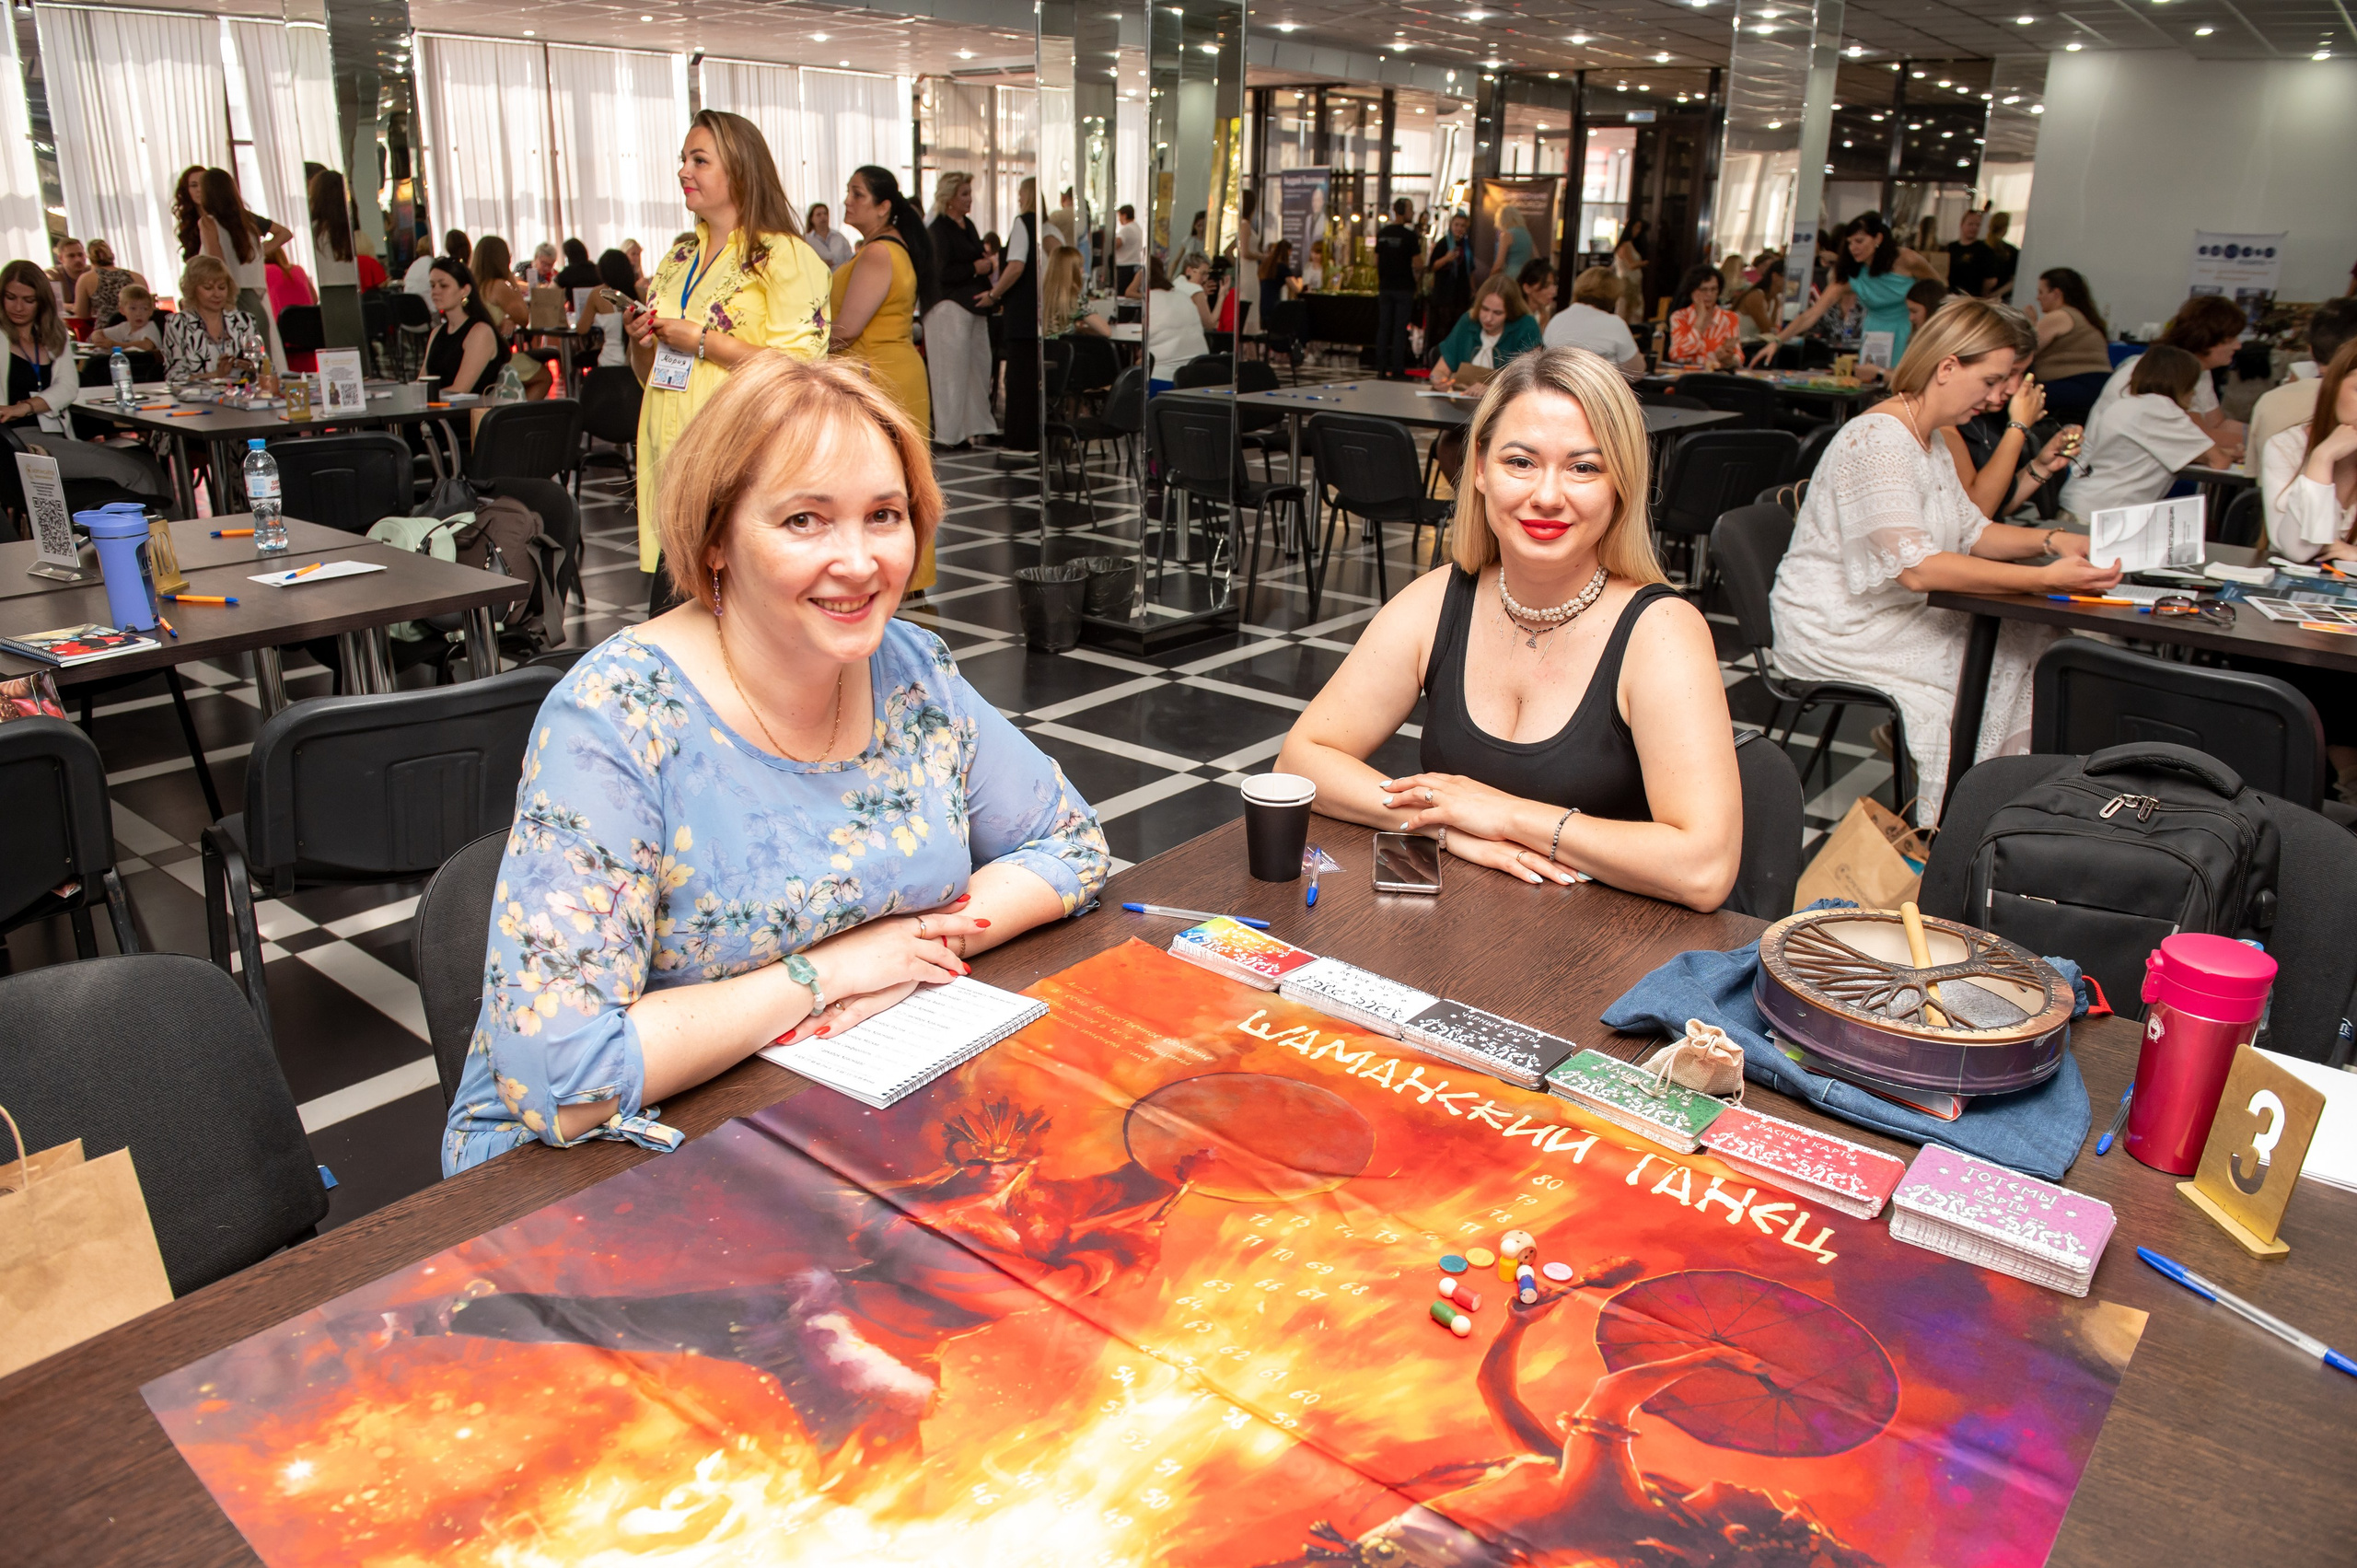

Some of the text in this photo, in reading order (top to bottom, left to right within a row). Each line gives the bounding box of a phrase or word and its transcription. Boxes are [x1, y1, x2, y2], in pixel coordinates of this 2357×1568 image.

[1462, 1011, 1540, 1044] ЧЕРНЫЕ КАРТЫ
[1237, 1008, 1839, 1265] ШАМАНСКИЙ ТАНЕЦ
[1749, 1120, 1858, 1161] КРАСНЫЕ КАРТЫ
[2226, 1088, 2286, 1196] 3
[1531, 1174, 1564, 1191] 80
[1966, 1166, 2058, 1205] ТОТЕМЫ
[1515, 1193, 1538, 1205] 79
[1972, 1188, 2030, 1214] КАРТЫ
[1248, 1213, 1273, 1227] 72
[1289, 1214, 1311, 1228] 73
[1489, 1208, 1513, 1224] 78
[1374, 1229, 1401, 1244] 75
[1271, 1248, 1295, 1262] 70
[1305, 1260, 1335, 1275] 69
[1202, 1279, 1236, 1293] 65
[1253, 1278, 1286, 1292] 66
[1338, 1282, 1370, 1295] 68
[1175, 1295, 1204, 1311] 64
[1295, 1289, 1329, 1301] 67
[1183, 1319, 1214, 1333] 63
[1218, 1346, 1252, 1361] 62
[1178, 1355, 1206, 1375] 56
[1109, 1365, 1137, 1388] 54
[1258, 1368, 1290, 1382] 61
[1288, 1388, 1322, 1405] 60
[1099, 1400, 1127, 1420] 53
[1222, 1406, 1253, 1430] 58
[1268, 1411, 1299, 1429] 59
[1120, 1428, 1153, 1452] 52
[1153, 1458, 1184, 1478] 51
[970, 1481, 1002, 1505] 46
[1140, 1487, 1171, 1509] 50
[1102, 1506, 1133, 1528] 49
